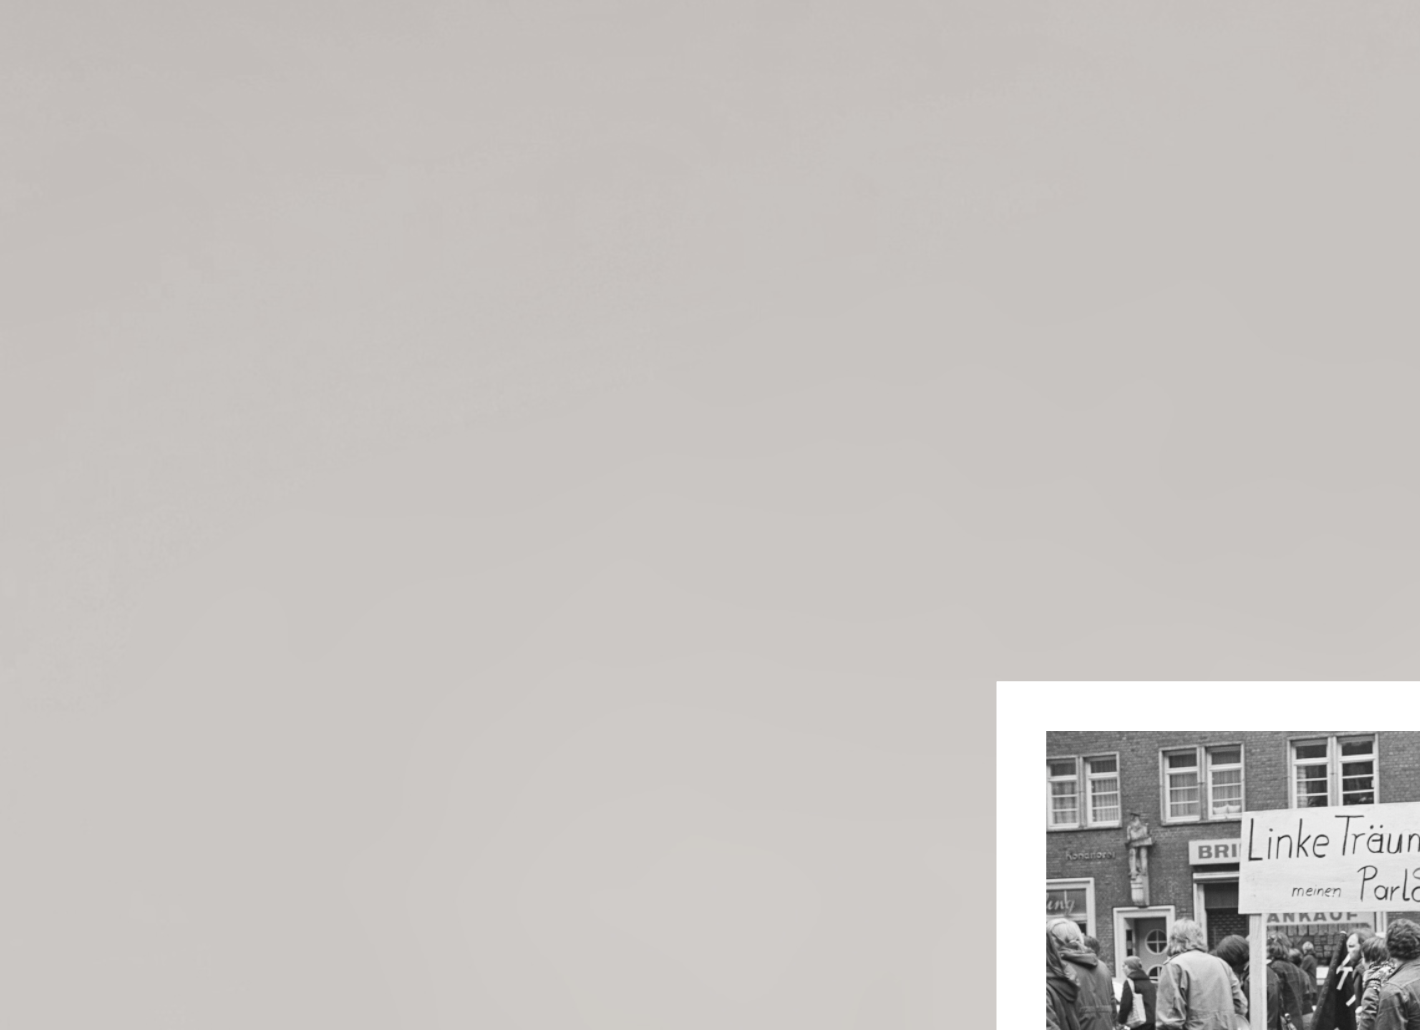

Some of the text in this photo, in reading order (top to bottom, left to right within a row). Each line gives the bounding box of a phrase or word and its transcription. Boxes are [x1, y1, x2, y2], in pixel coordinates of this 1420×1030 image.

[1248, 817, 1330, 862] Linke
[1198, 843, 1241, 860] BRI
[1291, 886, 1342, 898] meinen
